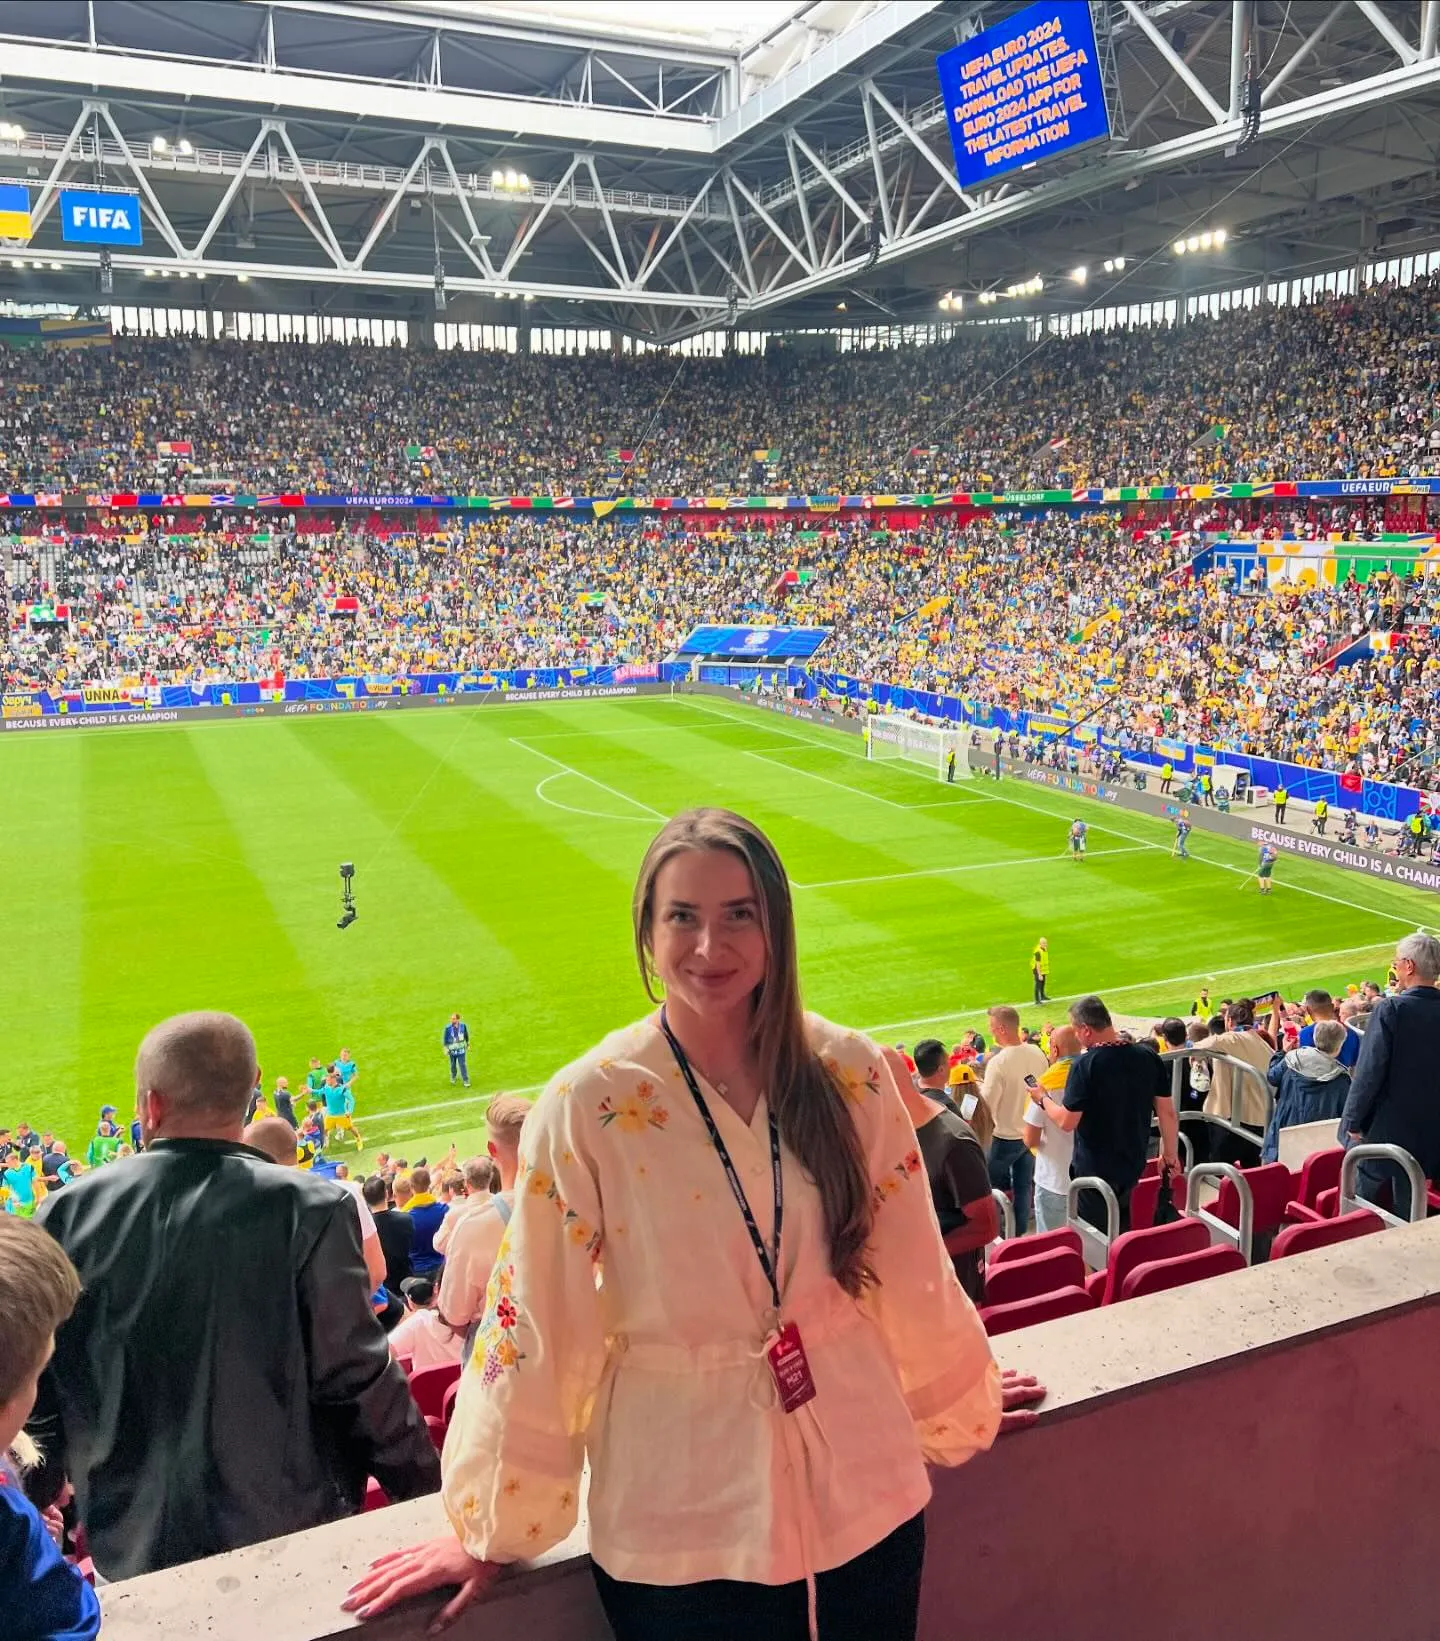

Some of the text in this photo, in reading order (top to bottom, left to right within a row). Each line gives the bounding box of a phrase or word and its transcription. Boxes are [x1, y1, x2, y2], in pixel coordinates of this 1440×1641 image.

[960, 16, 1062, 80] UEFA EURO 2024
[953, 49, 1088, 123] DOWNLOAD THE UEFA
[959, 67, 1007, 99] TRAVEL
[963, 73, 1082, 137] EURO 2024 APP FOR
[964, 94, 1087, 155] THE LATEST TRAVEL
[984, 120, 1070, 167] INFORMATION
[72, 206, 131, 230] FIFA
[84, 689, 120, 702] UNNA
[505, 692, 538, 701] BECAUSE
[538, 691, 561, 699] EVERY
[561, 690, 582, 698] CHILD
[598, 686, 637, 695] CHAMPION
[5, 711, 178, 729] BECAUSE EVERY CHILD IS A CHAMPION
[1251, 827, 1296, 849] BECAUSE
[1299, 839, 1331, 858] EVERY
[1333, 851, 1367, 868] CHILD
[1370, 858, 1382, 871] IS
[1383, 863, 1394, 876] A
